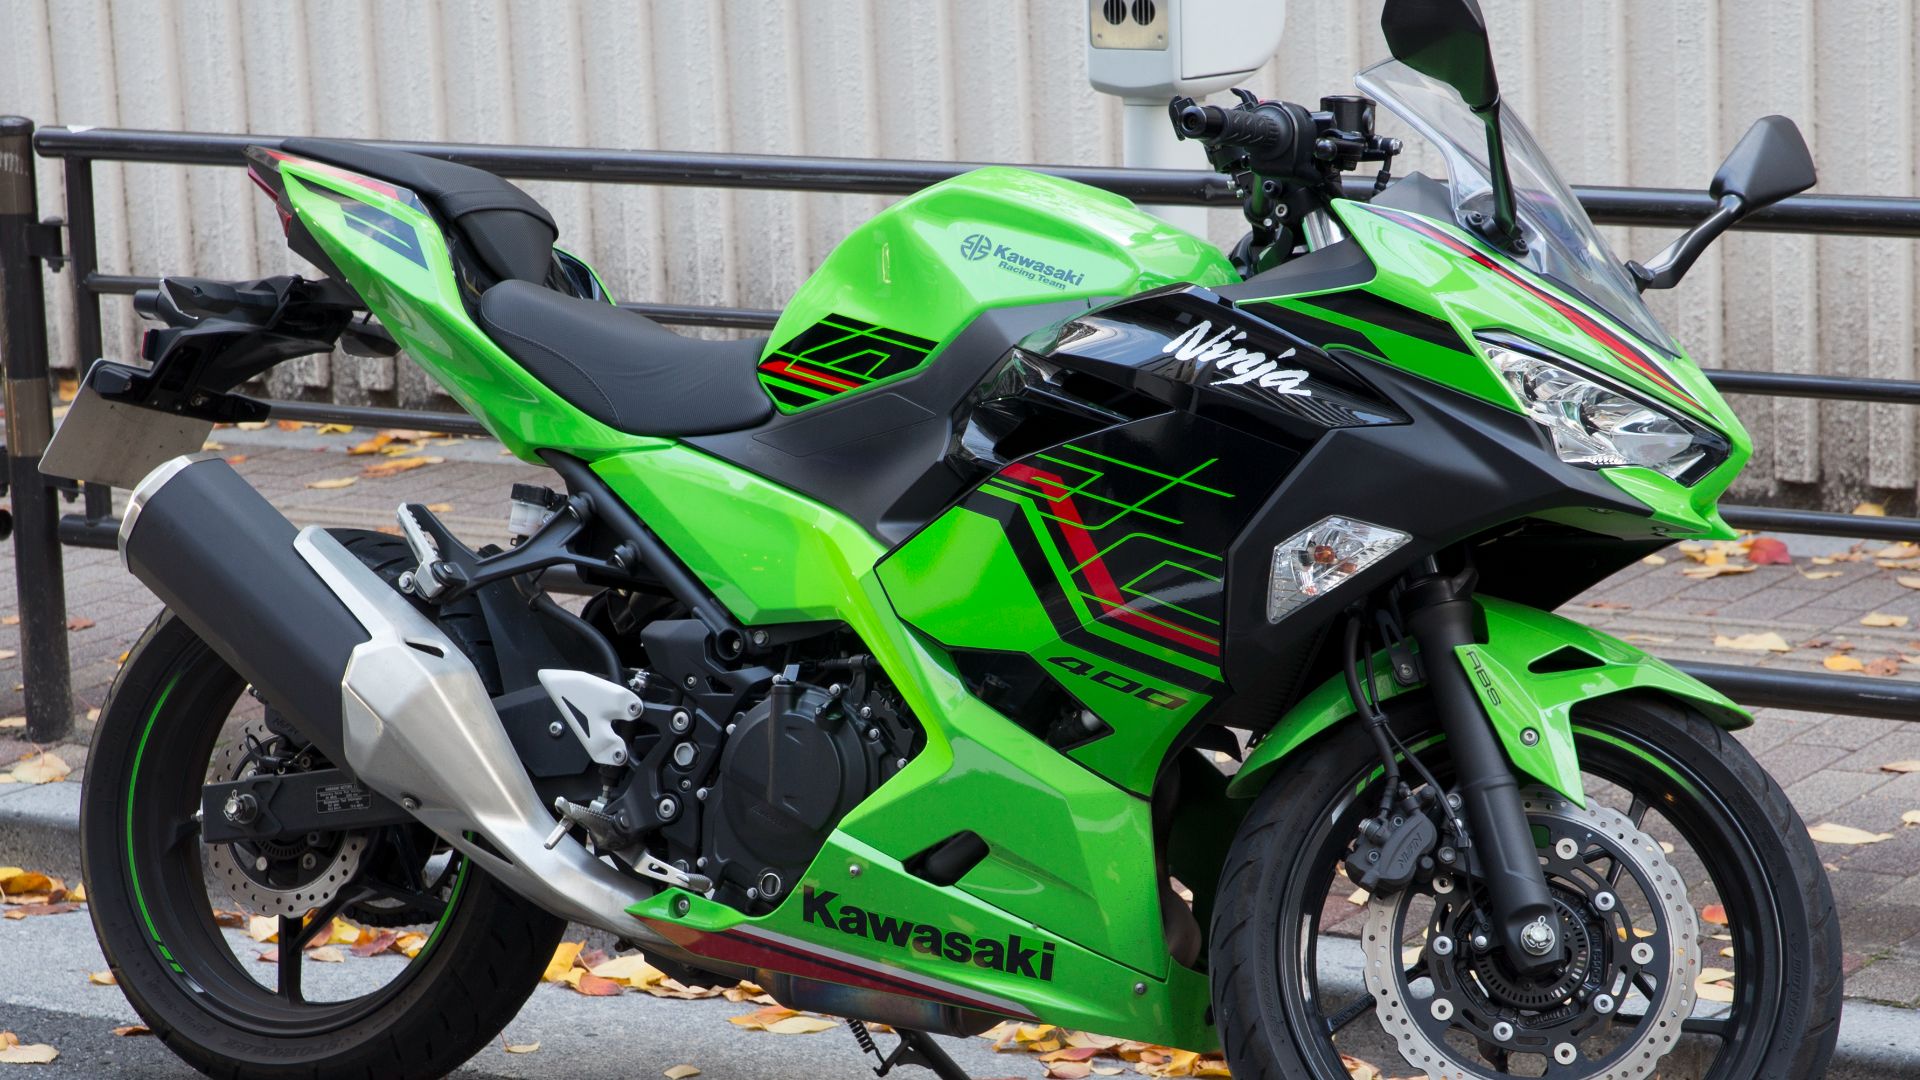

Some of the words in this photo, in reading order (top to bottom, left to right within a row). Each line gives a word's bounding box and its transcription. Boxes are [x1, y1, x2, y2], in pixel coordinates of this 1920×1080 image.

[993, 244, 1085, 287] Kawasaki
[998, 261, 1035, 280] Racing
[1038, 274, 1066, 290] Team
[1162, 319, 1312, 397] Ninja
[1046, 656, 1189, 710] 400
[1466, 651, 1501, 706] ABS
[802, 884, 1056, 982] Kawasaki
